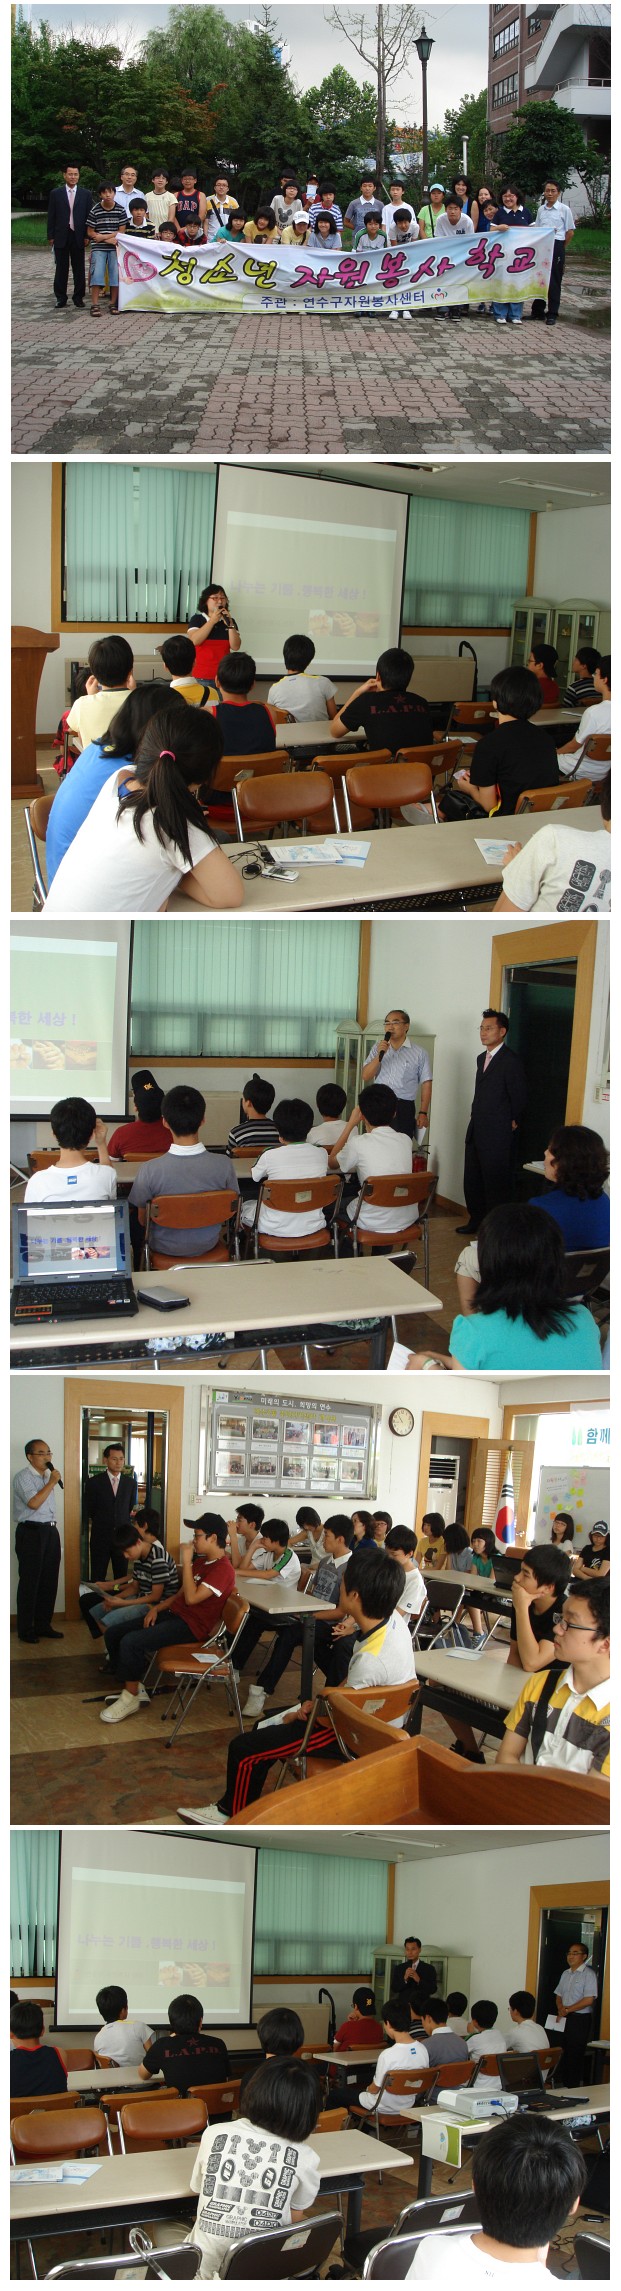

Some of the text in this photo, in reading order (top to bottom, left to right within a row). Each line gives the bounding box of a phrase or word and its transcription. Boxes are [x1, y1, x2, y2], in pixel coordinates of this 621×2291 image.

[158, 237, 537, 290] 청소년 자원봉사 학교
[260, 296, 287, 309] 주관
[302, 290, 426, 309] 연수구자원봉사센터
[37, 1010, 67, 1027] 세상
[260, 1396, 280, 1407] 미래의
[299, 1401, 318, 1411] 희망의
[319, 1403, 332, 1411] 연수
